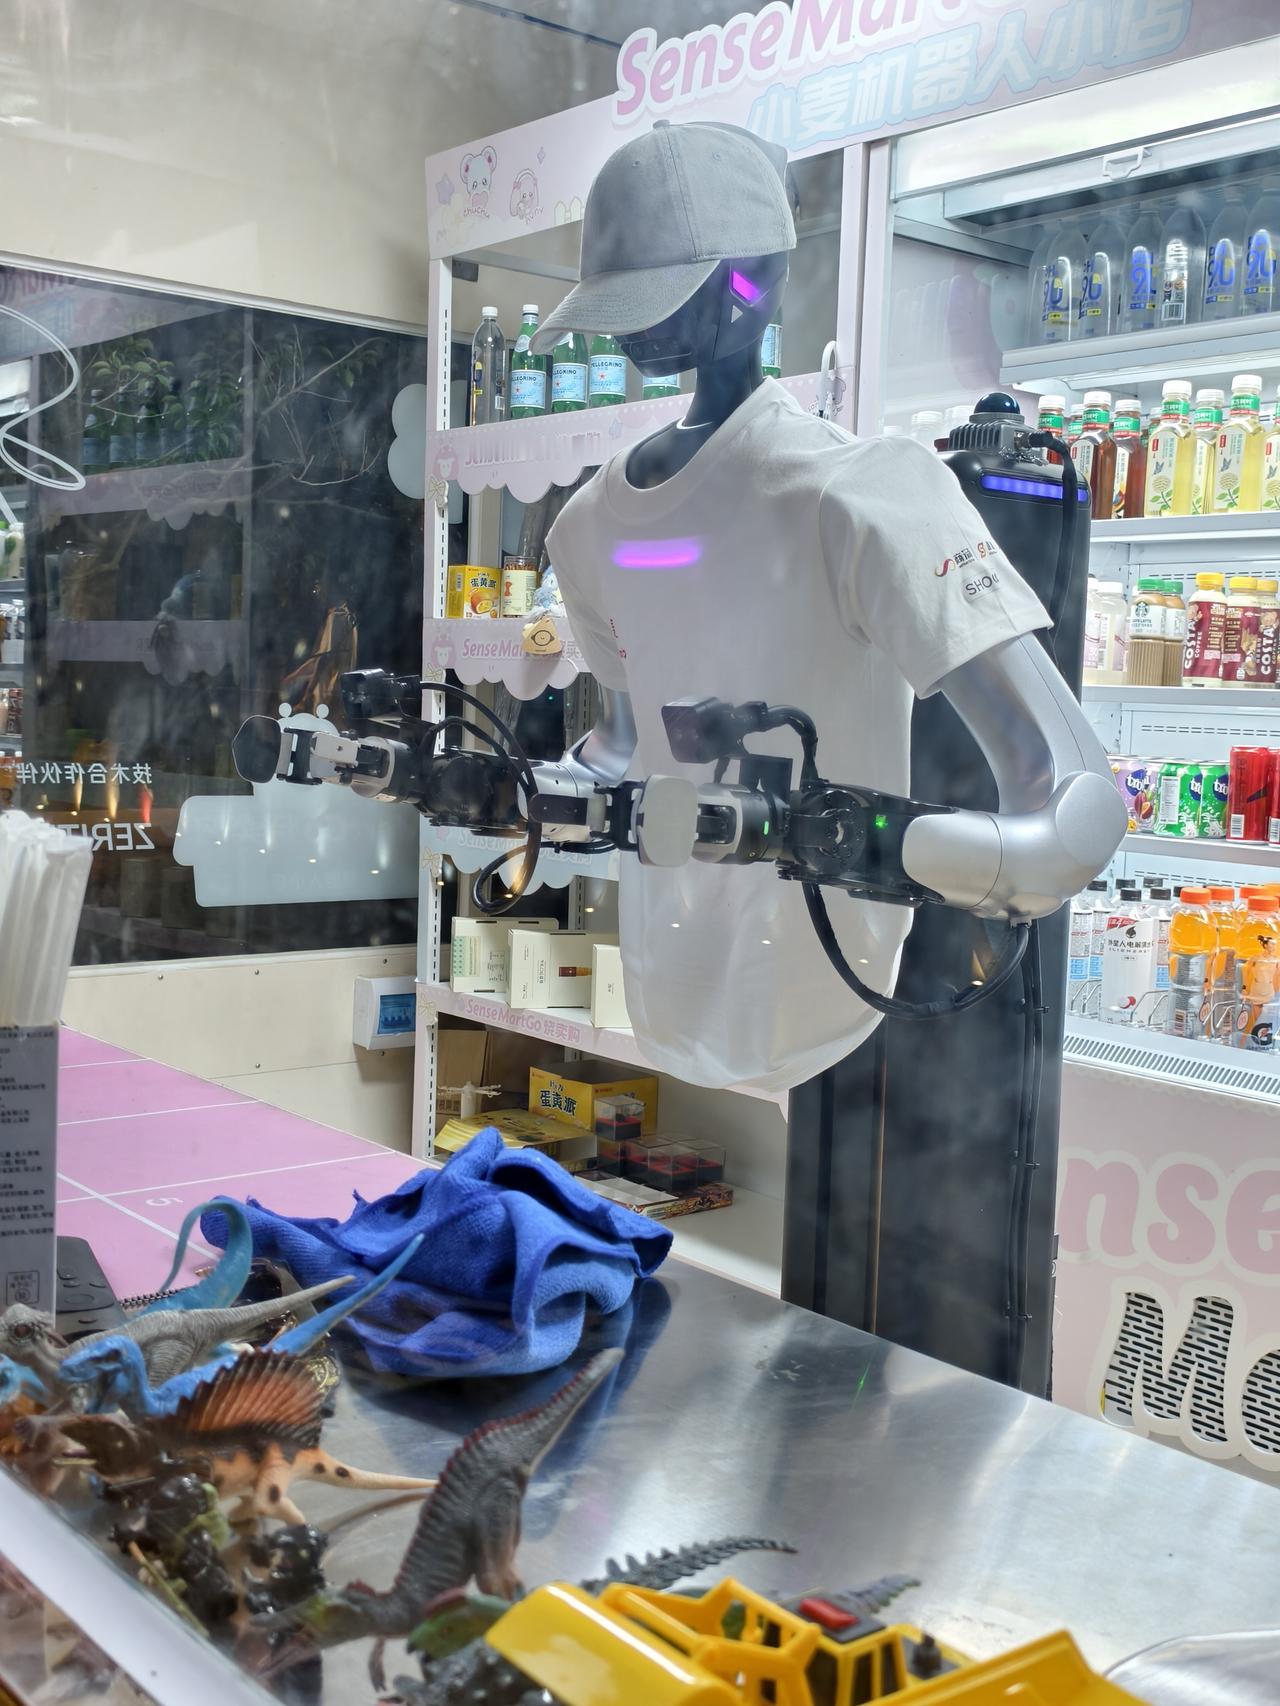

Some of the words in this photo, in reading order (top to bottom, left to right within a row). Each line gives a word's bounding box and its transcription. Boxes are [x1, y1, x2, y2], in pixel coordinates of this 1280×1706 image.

[617, 0, 960, 116] SenseMa
[751, 0, 1184, 142] 小麦机器人小店
[463, 638, 523, 657] SenseMar
[1184, 620, 1197, 670] COSTA
[1260, 626, 1275, 675] COSTA
[466, 999, 542, 1033] SenseMartGo
[540, 1089, 577, 1116] 蛋黄派
